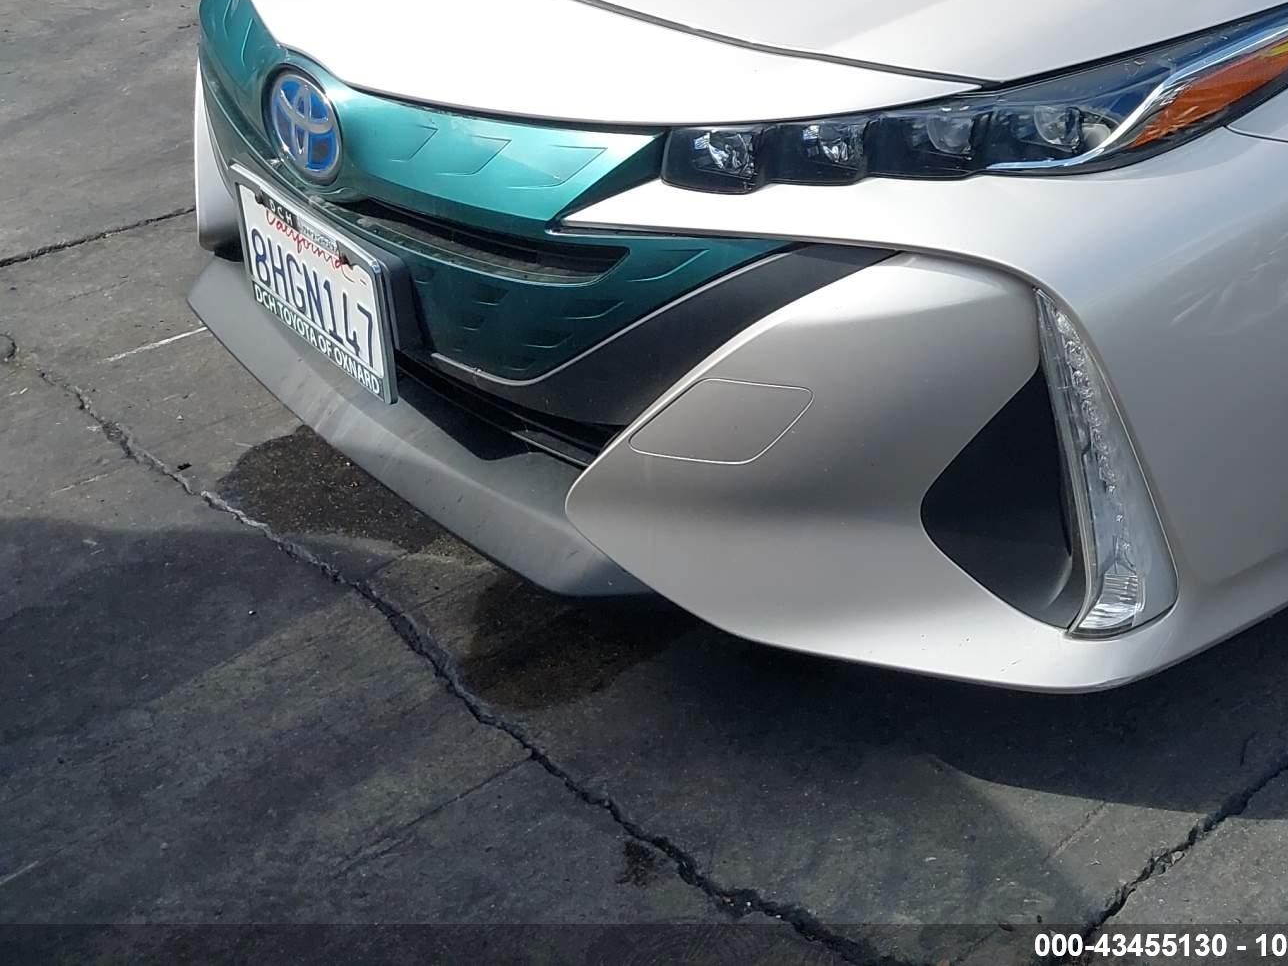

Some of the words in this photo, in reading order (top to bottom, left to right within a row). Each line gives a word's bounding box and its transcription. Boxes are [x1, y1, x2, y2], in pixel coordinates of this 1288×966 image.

[269, 199, 294, 226] DCH
[250, 228, 374, 368] 8HGN147
[255, 284, 278, 312] DCH
[278, 303, 318, 348] TOYOTA
[319, 339, 333, 359] OF
[334, 350, 380, 395] OXNARD
